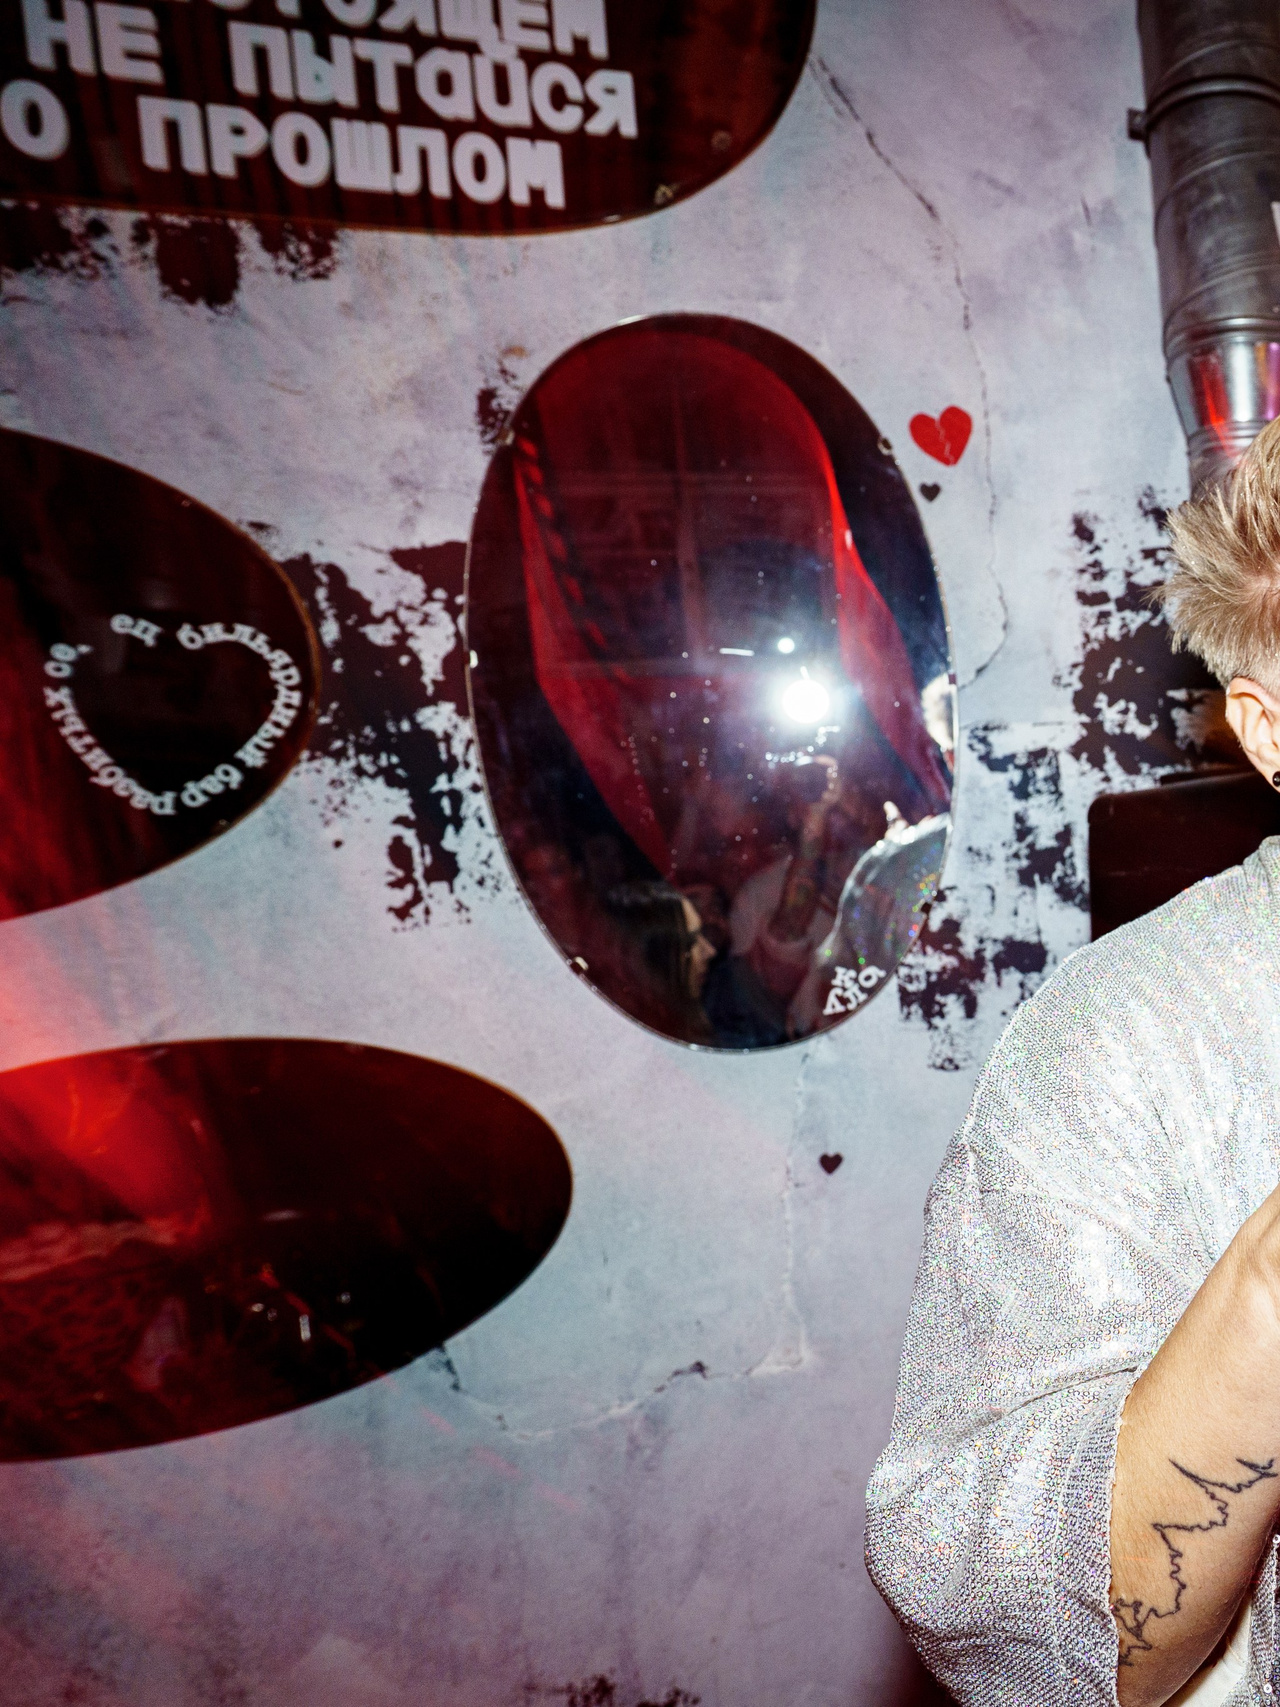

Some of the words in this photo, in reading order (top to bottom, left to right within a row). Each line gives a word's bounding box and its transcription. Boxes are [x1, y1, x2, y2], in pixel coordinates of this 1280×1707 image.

[21, 0, 164, 85] НЕ
[136, 94, 566, 210] ПРОШЛОМ
[180, 763, 244, 808] бар
